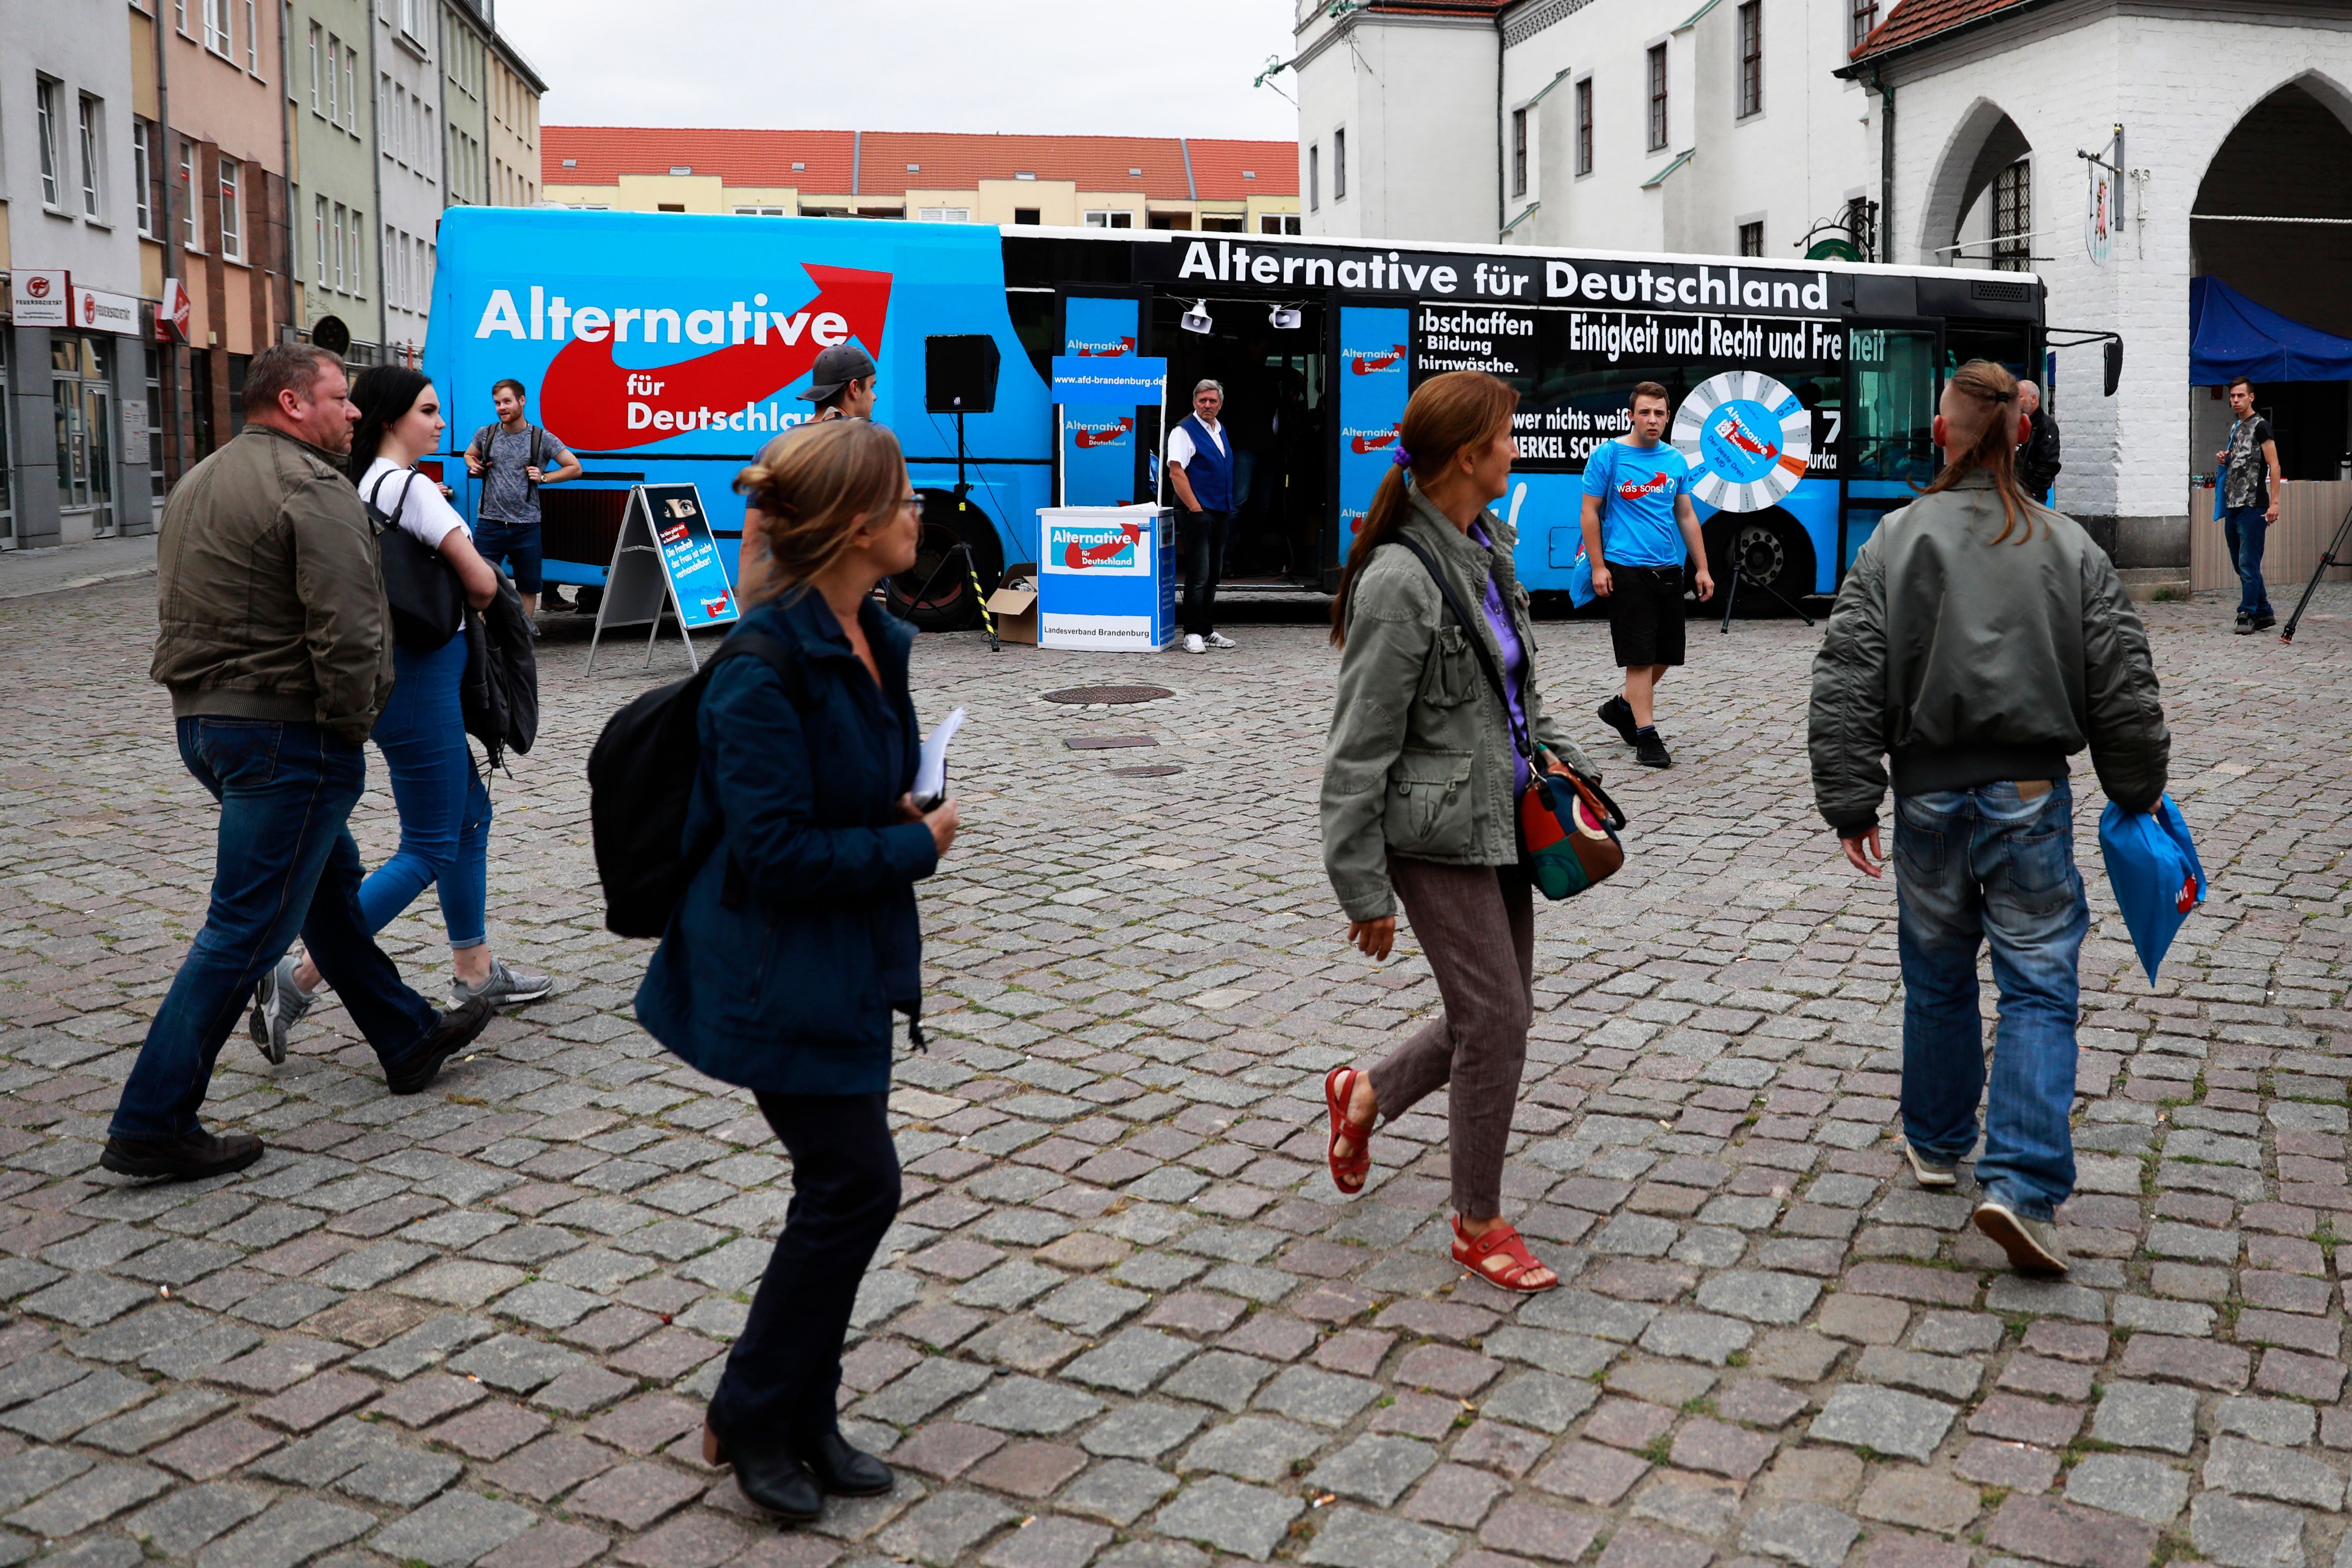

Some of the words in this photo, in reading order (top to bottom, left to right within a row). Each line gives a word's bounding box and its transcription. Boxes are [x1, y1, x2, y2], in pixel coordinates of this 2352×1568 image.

[1178, 240, 1458, 292] Alternative
[1474, 263, 1529, 296] für
[1546, 261, 1827, 310] Deutschland
[474, 285, 848, 347] Alternative
[1067, 340, 1129, 351] Alternative
[1428, 335, 1492, 355] Bildung
[1570, 312, 1658, 361] Einigkeit
[1665, 316, 1703, 354] und
[1710, 319, 1762, 357] Recht
[1769, 321, 1806, 359] und
[1812, 323, 1885, 361] Freheit
[1342, 348, 1400, 359] Alternative
[626, 373, 665, 396] für
[627, 402, 816, 432] Deutschla
[1065, 420, 1127, 432] Alternative
[1512, 413, 1542, 429] wer
[1546, 406, 1591, 430] nichts
[1822, 410, 1841, 443] 7
[1342, 426, 1400, 437] Alternative
[1724, 405, 1768, 455] Alternative
[1707, 435, 1718, 449] Der
[1717, 446, 1732, 463] beste
[1730, 462, 1745, 478] Dreh
[1729, 434, 1757, 465] Deutschland
[1806, 447, 1837, 469] urka
[1713, 457, 1726, 468] AfD
[1640, 482, 1664, 493] sonst
[665, 547, 676, 558] Die
[674, 538, 694, 554] Freiheit
[1053, 530, 1132, 544] Alternative
[671, 558, 681, 569] der
[678, 553, 693, 564] Frau
[690, 549, 700, 559] ist
[698, 543, 713, 556] nicht
[1081, 556, 1132, 566] Deutschland
[675, 555, 712, 580] verhandelbar!
[700, 595, 727, 606] Alternative
[1044, 626, 1096, 636] Landesverband
[1099, 628, 1150, 639] Brandenburg
